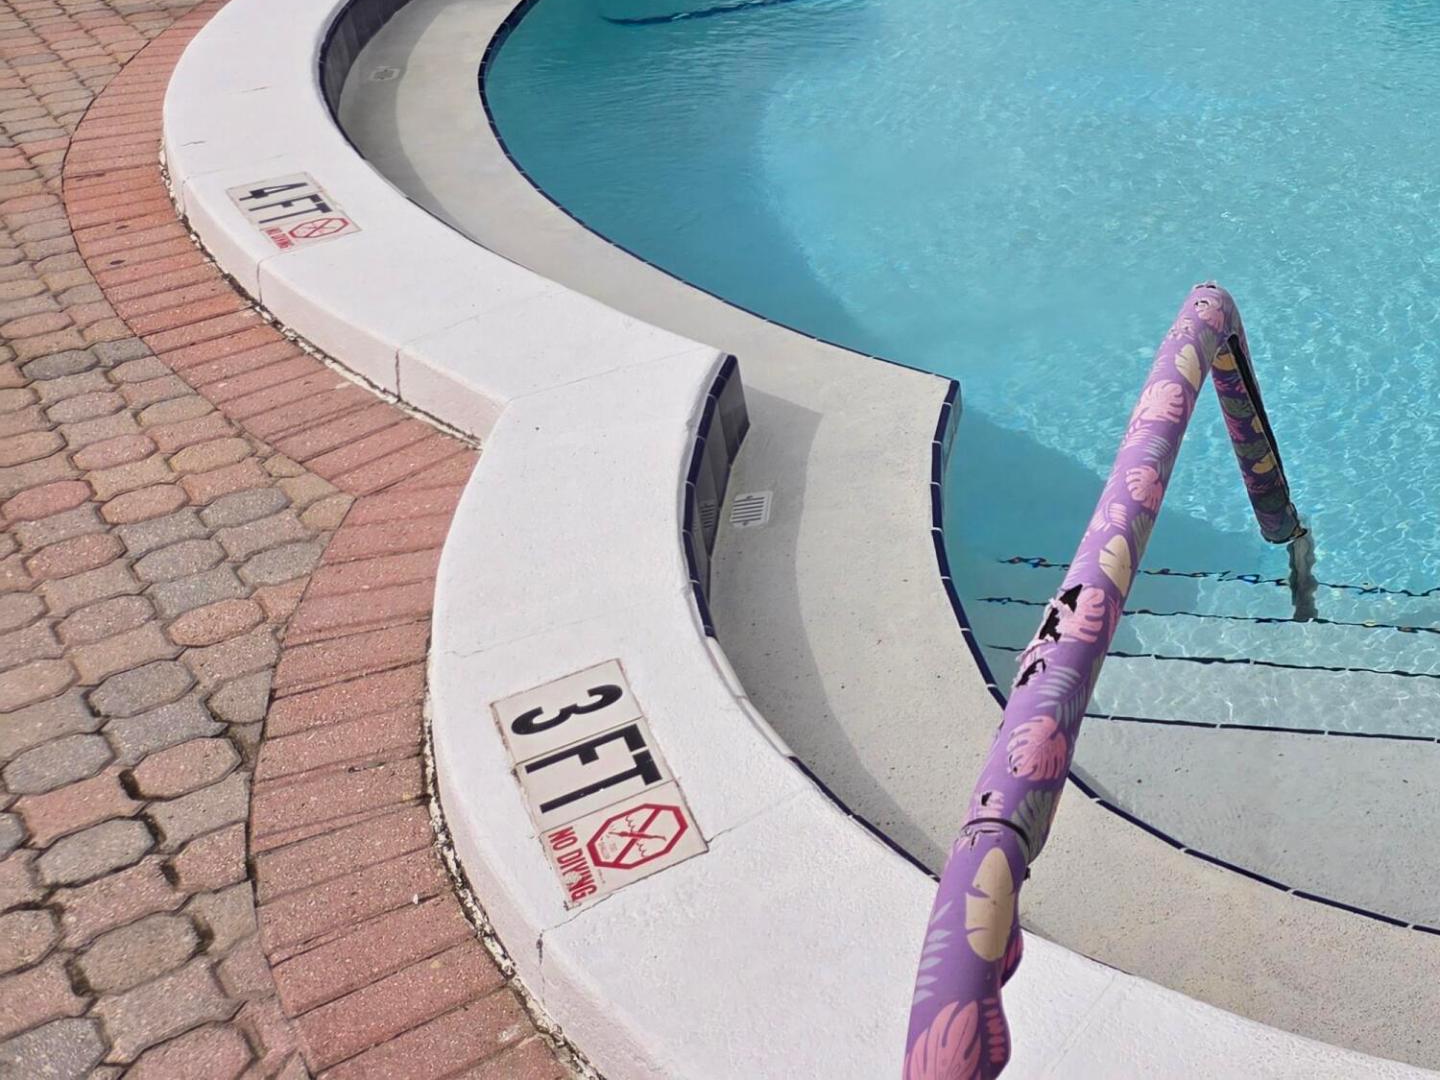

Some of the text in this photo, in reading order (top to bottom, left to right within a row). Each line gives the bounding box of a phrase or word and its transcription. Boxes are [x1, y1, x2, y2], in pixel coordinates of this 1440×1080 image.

[239, 182, 333, 224] 4 FT
[511, 684, 663, 814] 3 FT
[548, 826, 579, 851] NO
